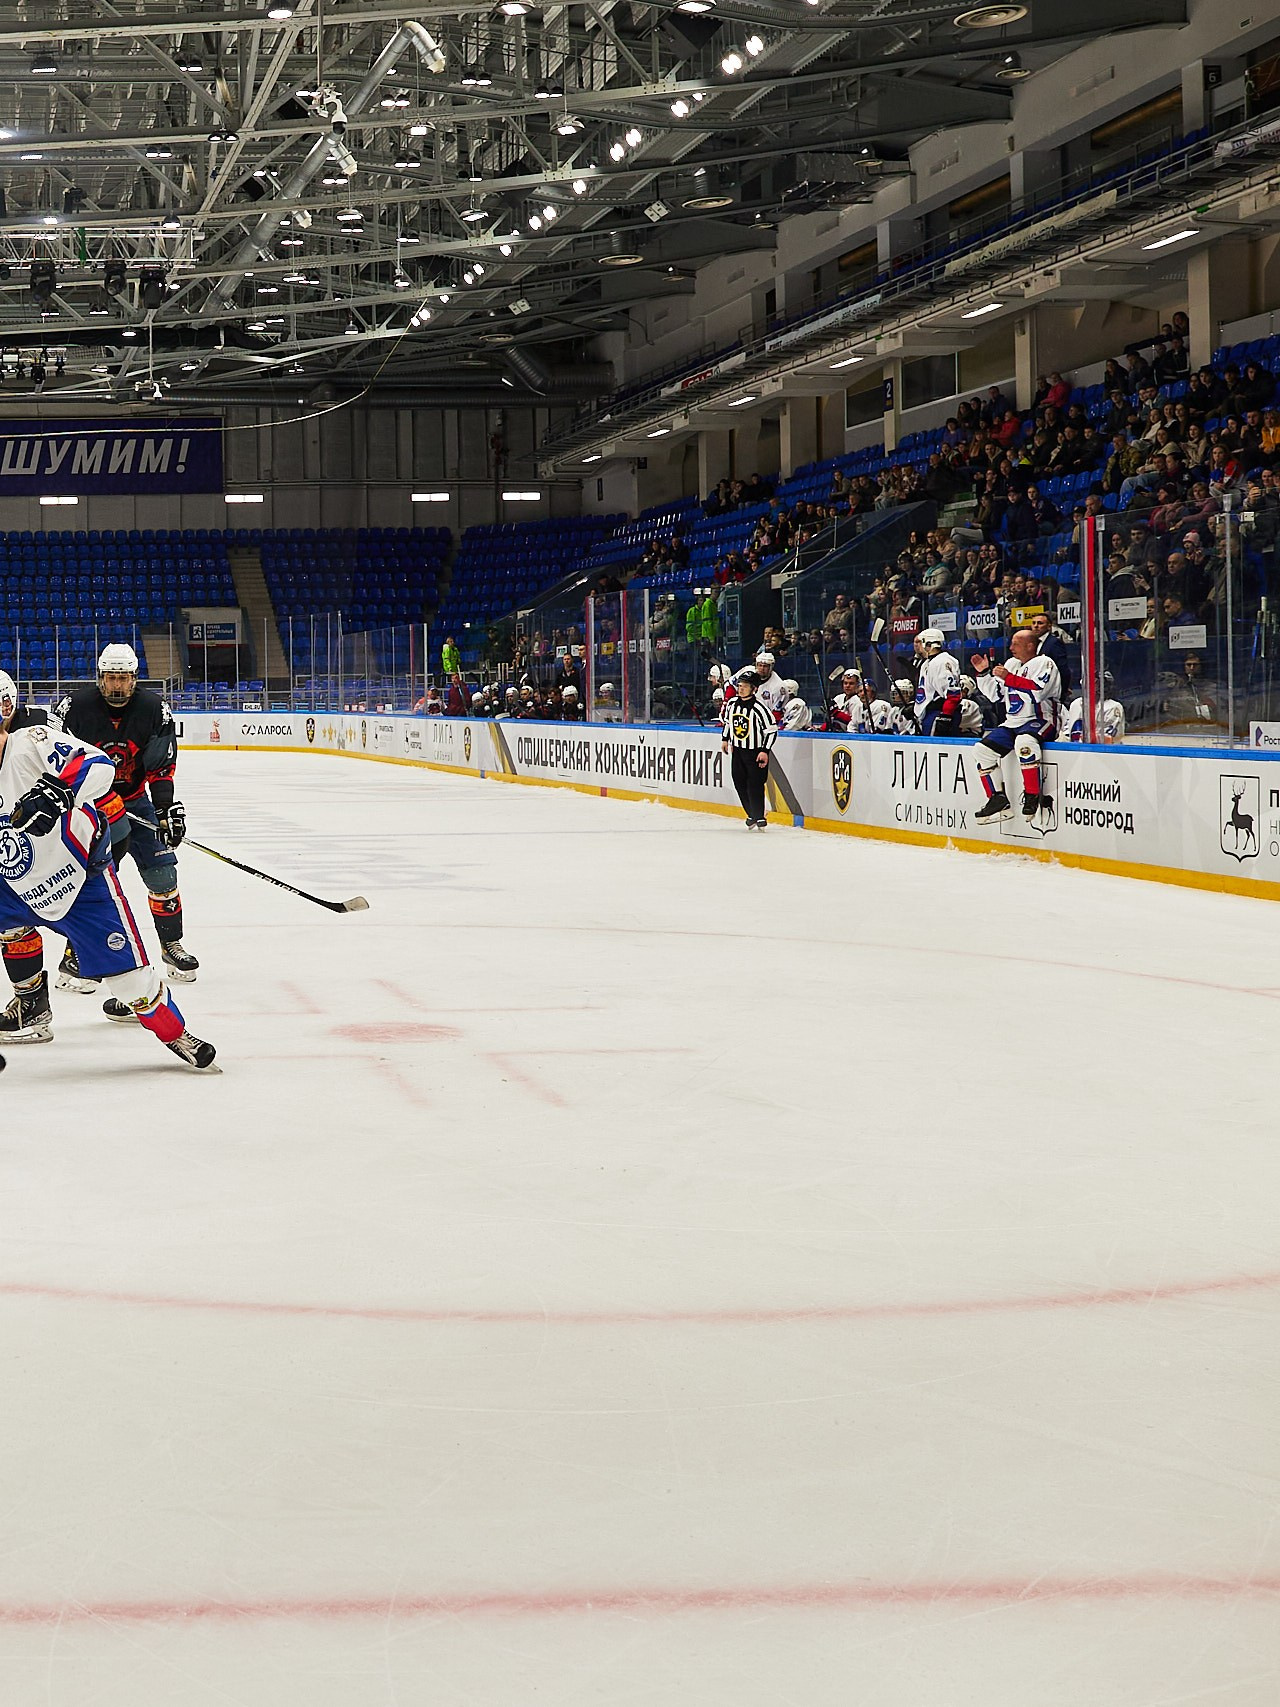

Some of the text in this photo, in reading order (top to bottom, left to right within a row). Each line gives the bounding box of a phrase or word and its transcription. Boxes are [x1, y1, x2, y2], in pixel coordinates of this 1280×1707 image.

[893, 619, 918, 632] FONBET
[47, 741, 74, 773] 26
[518, 735, 723, 788] ОФИЦЕРСКАЯ ХОККЕЙНАЯ ЛИГА
[891, 750, 969, 795] ЛИГА
[1064, 779, 1121, 803] НИЖНИЙ
[895, 803, 968, 830] СИЛЬНЫХ
[1065, 806, 1135, 835] НОВГОРОД
[45, 863, 77, 888] УМВД
